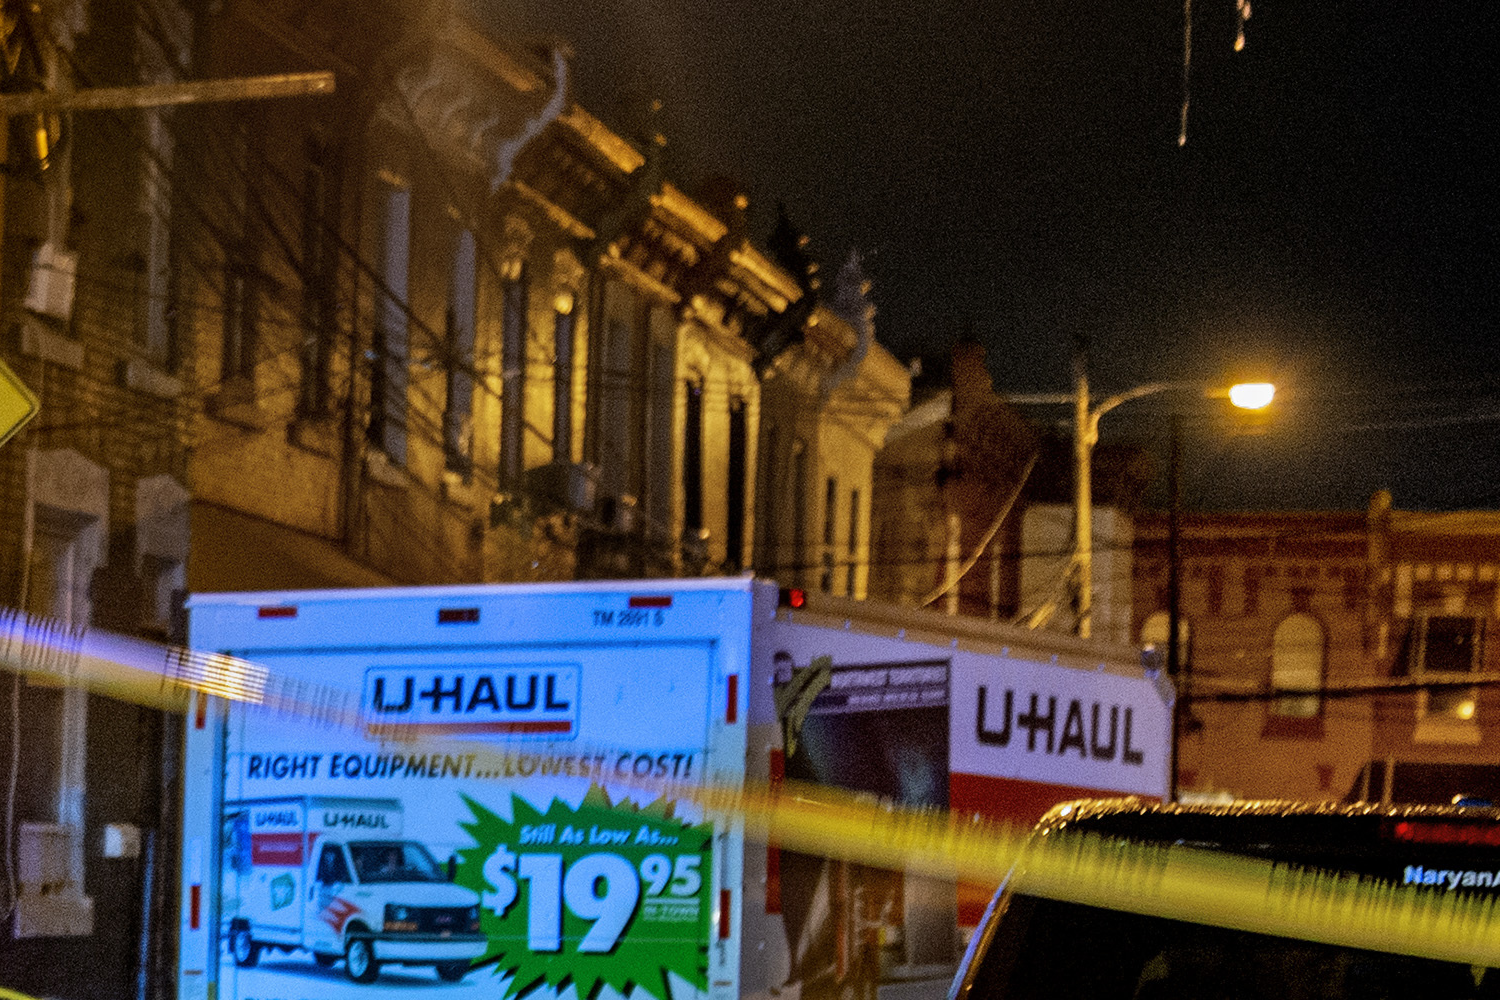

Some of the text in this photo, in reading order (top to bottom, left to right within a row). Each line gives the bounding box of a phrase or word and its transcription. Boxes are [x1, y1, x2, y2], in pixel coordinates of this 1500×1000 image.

[373, 674, 570, 713] U-HAUL
[975, 684, 1145, 766] U-HAUL
[247, 753, 323, 779] RIGHT
[613, 752, 694, 779] COST!
[518, 823, 557, 846] Still
[559, 825, 585, 846] As
[588, 824, 632, 846] Low
